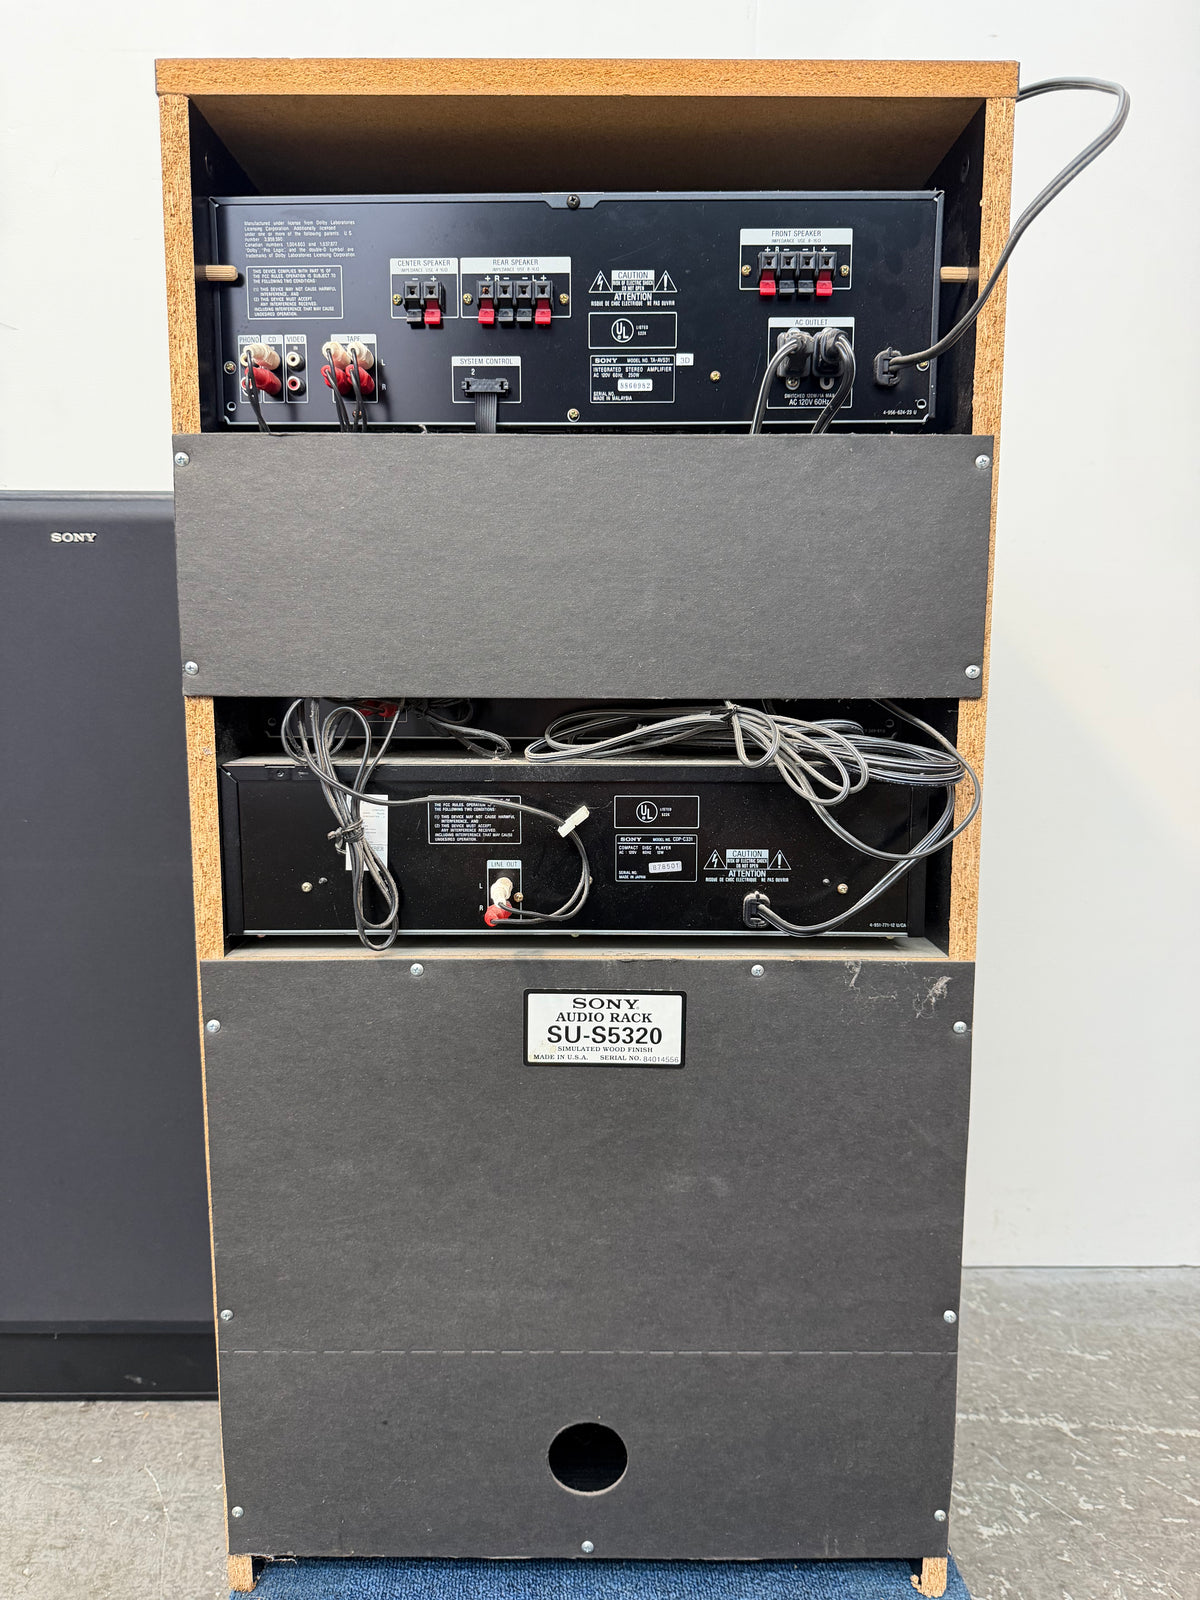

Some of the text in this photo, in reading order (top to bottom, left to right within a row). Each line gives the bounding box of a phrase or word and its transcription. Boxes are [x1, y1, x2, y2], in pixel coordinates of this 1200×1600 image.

[51, 533, 96, 542] SONY
[573, 998, 639, 1009] SONY
[556, 1012, 652, 1022] AUDIO RACK
[547, 1026, 662, 1044] SU-S5320
